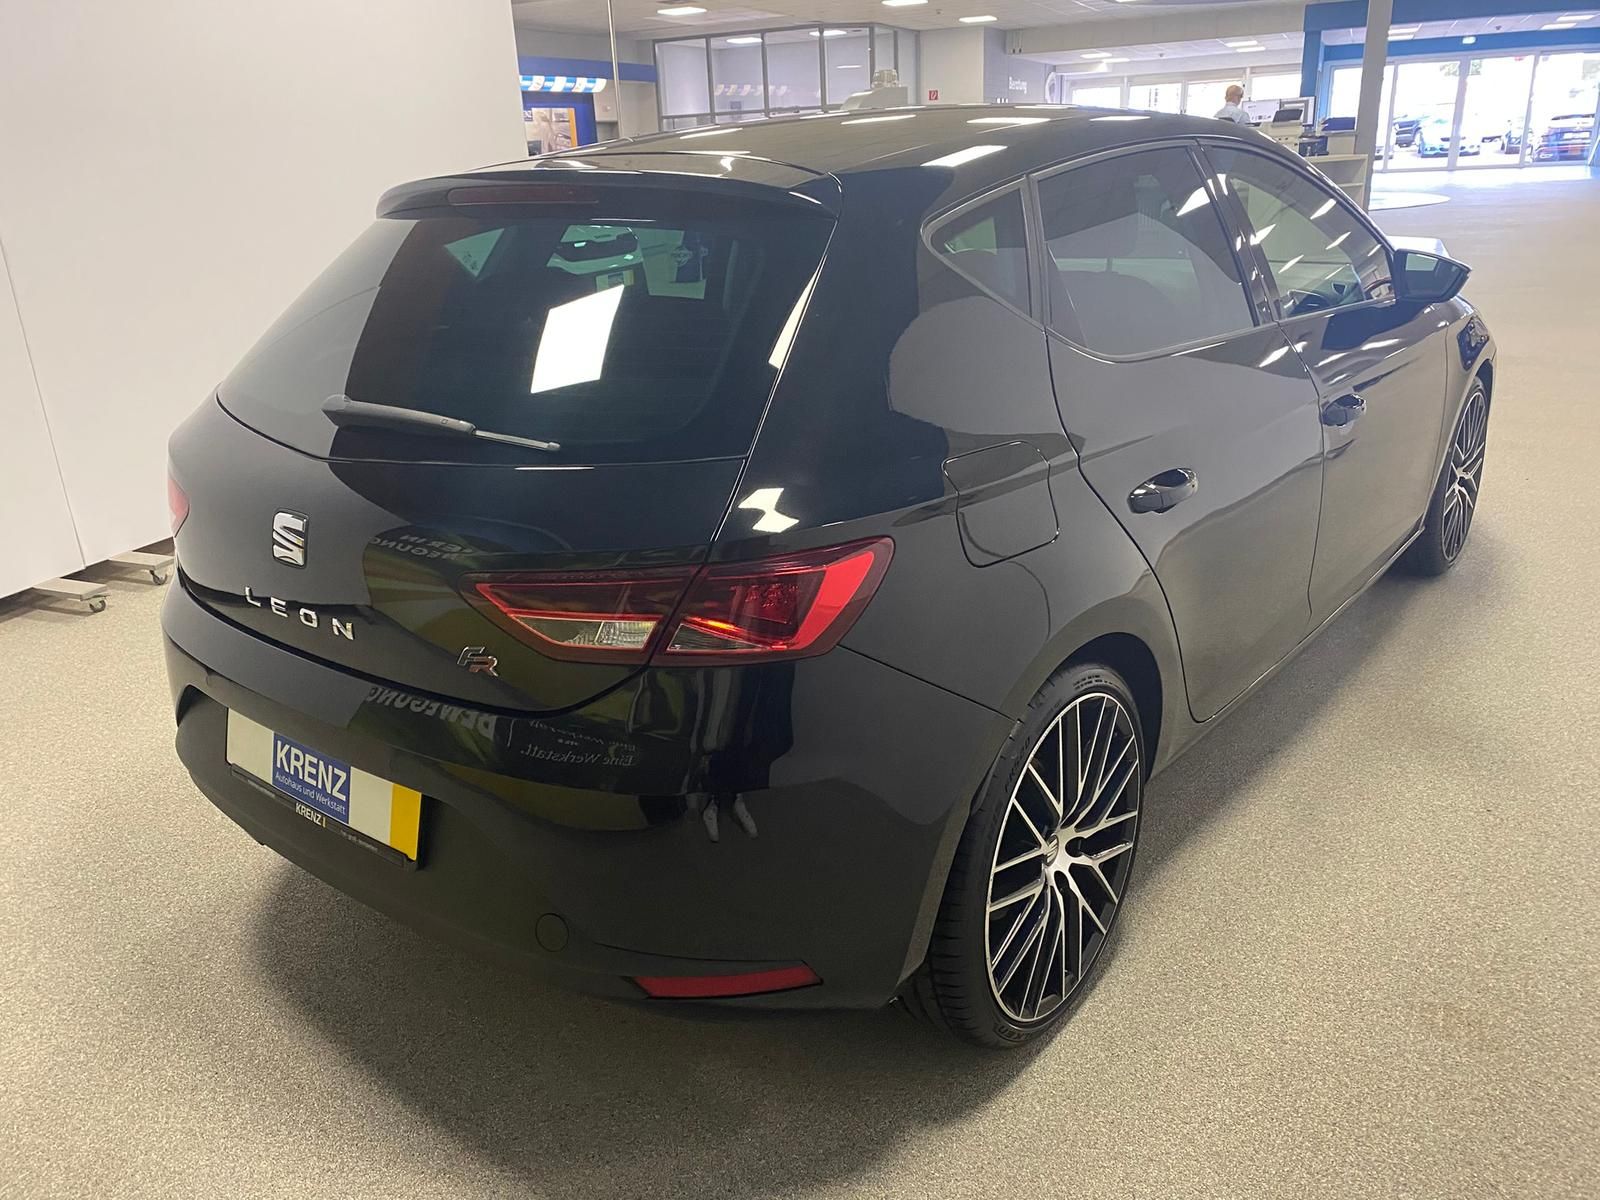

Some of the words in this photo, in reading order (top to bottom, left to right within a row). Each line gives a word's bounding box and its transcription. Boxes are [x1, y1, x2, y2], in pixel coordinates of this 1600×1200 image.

[244, 586, 354, 641] LEON
[456, 646, 499, 677] FR
[274, 771, 303, 793] Autohaus
[303, 787, 315, 799] und
[315, 791, 346, 815] Werkstatt
[276, 740, 347, 802] KRENZ
[295, 802, 322, 826] KRENZ
